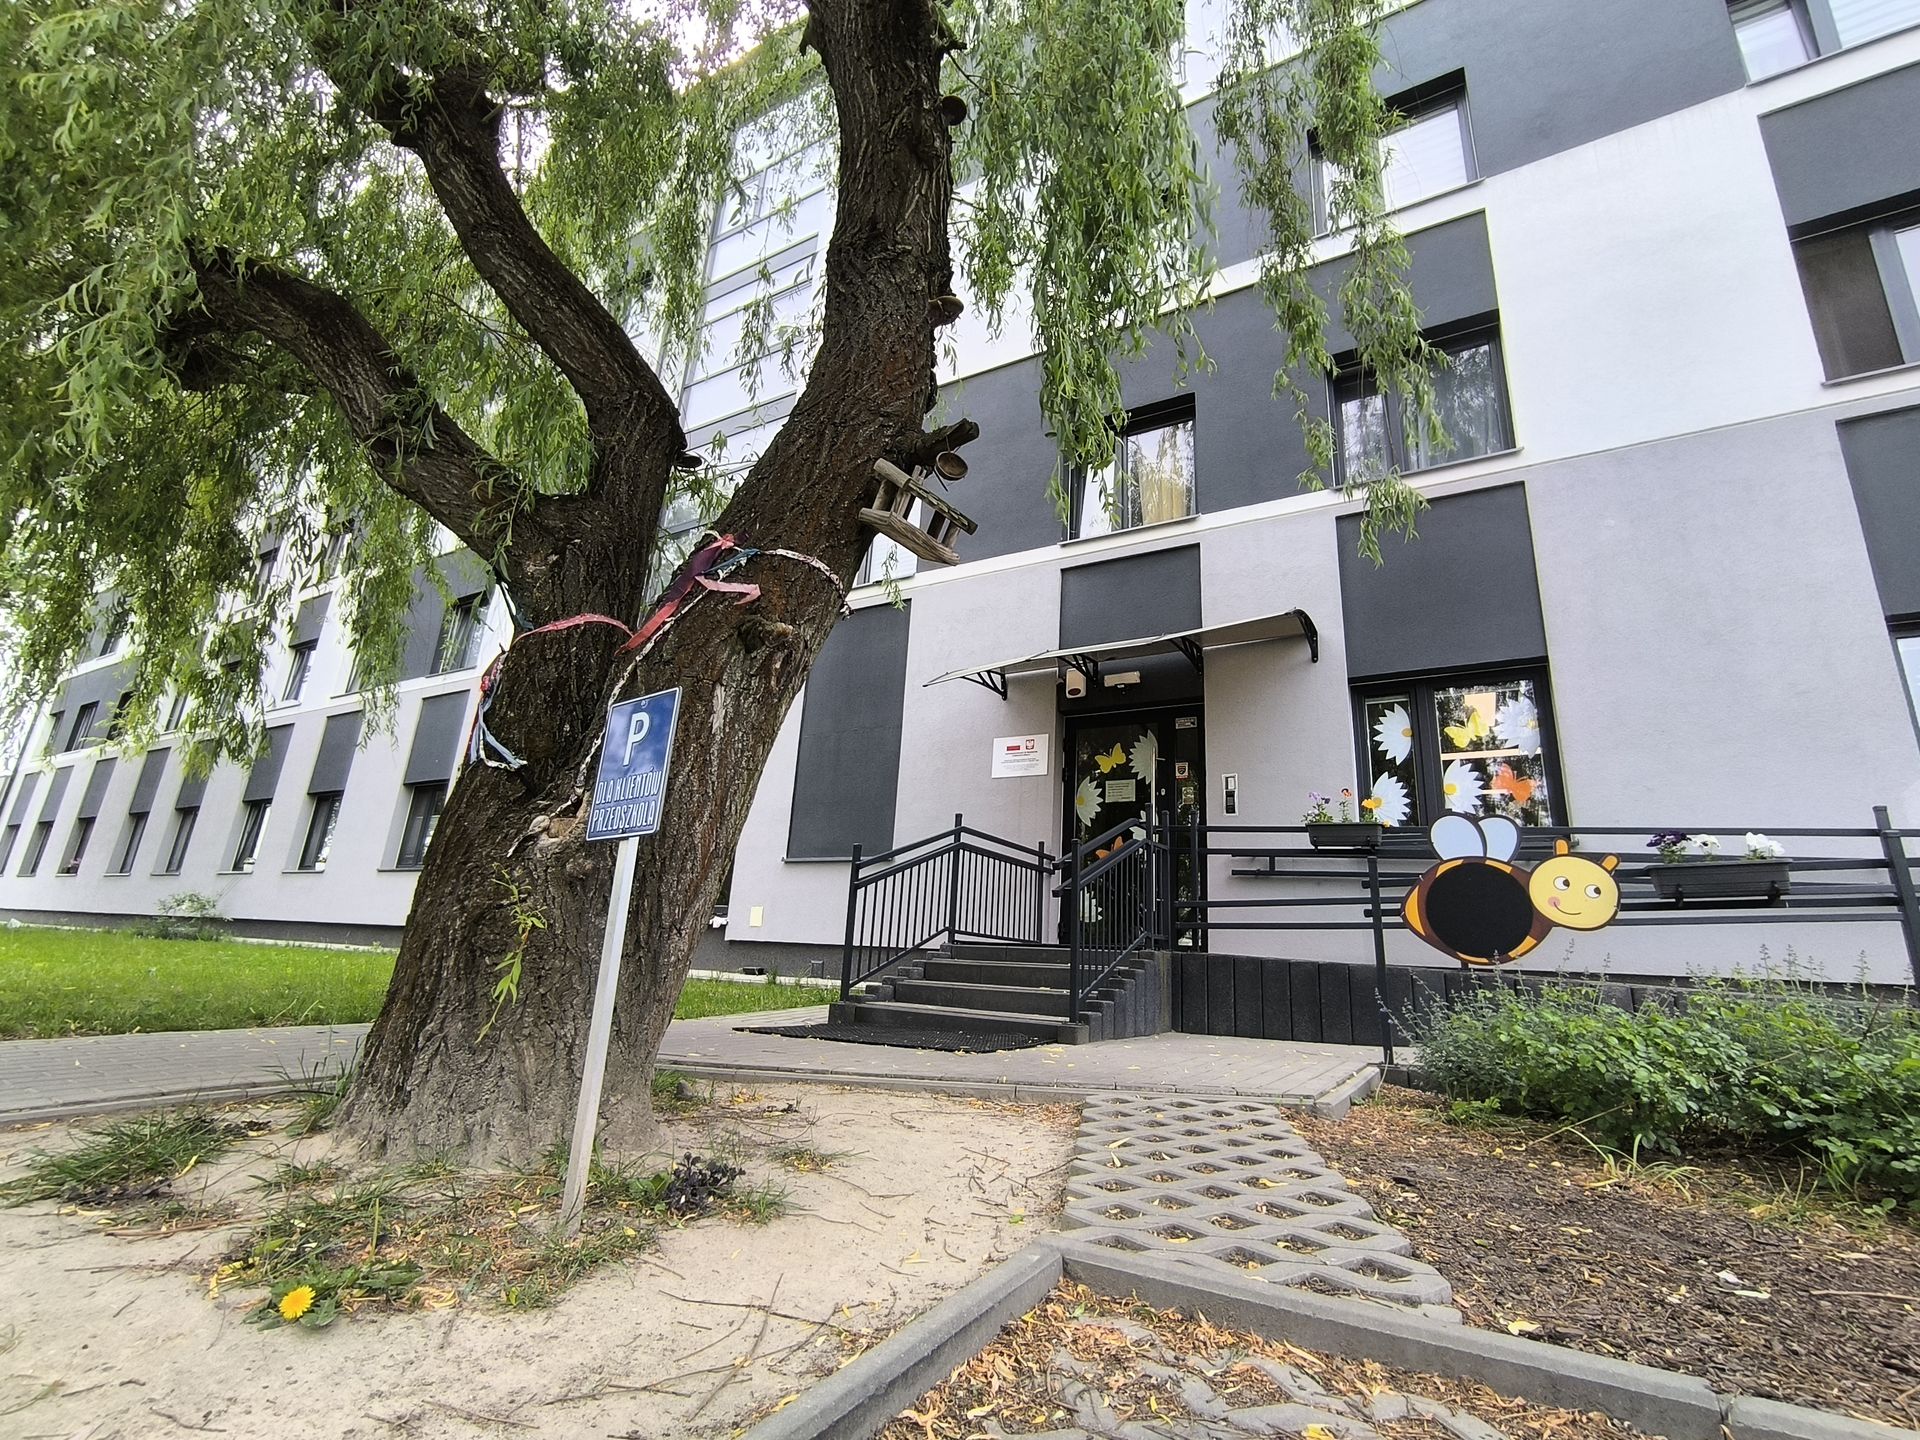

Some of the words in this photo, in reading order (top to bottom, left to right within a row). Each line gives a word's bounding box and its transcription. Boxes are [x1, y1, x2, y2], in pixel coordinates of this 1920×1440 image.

[623, 711, 650, 766] P
[596, 780, 613, 804] DLA
[614, 767, 662, 802] KLIENTÓW
[591, 801, 656, 832] PRZEDSZKOLA
